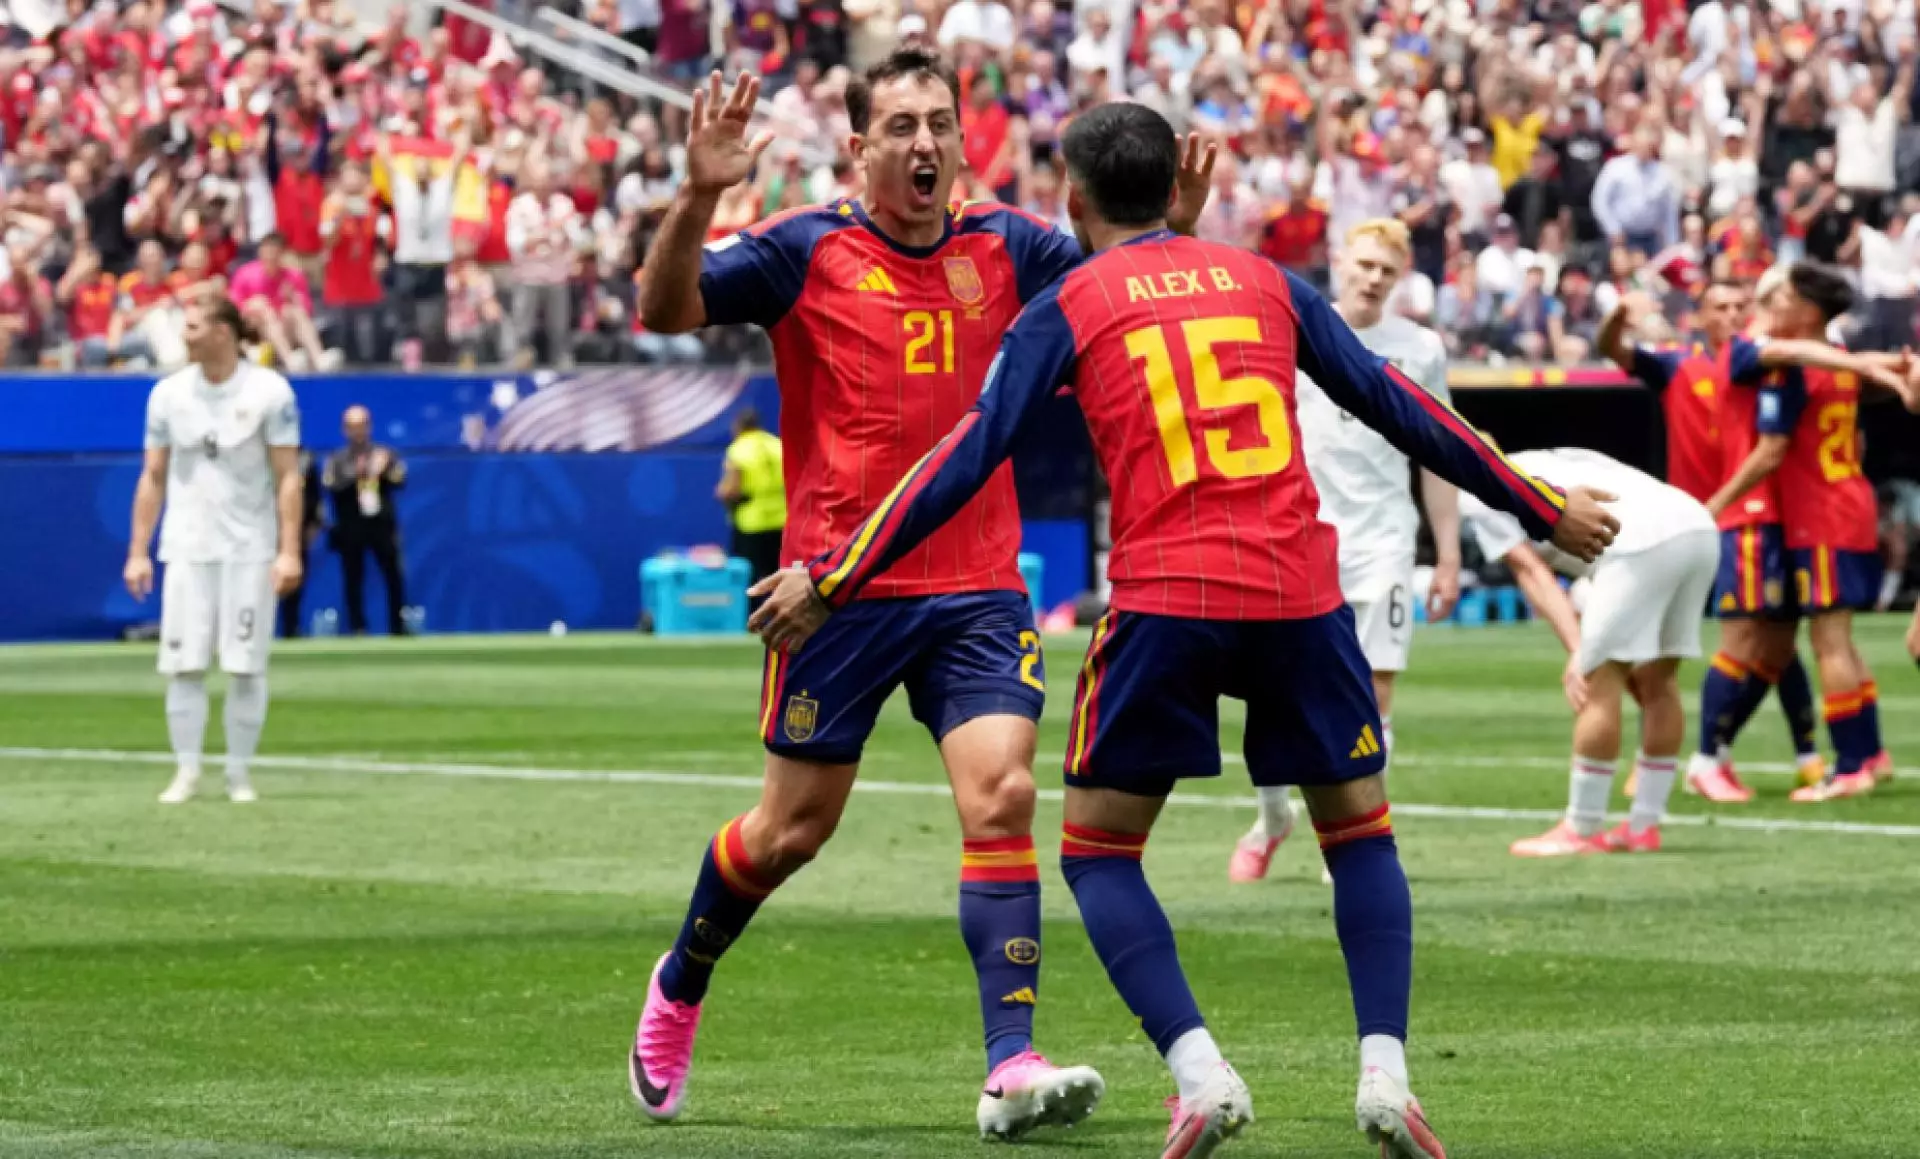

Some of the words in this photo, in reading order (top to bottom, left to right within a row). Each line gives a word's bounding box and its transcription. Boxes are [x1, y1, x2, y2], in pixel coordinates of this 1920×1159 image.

[1125, 268, 1207, 302] ALEX
[1208, 265, 1243, 292] B.
[903, 309, 955, 375] 21
[1123, 315, 1292, 488] 15
[238, 607, 255, 642] 9
[1388, 583, 1405, 629] 6
